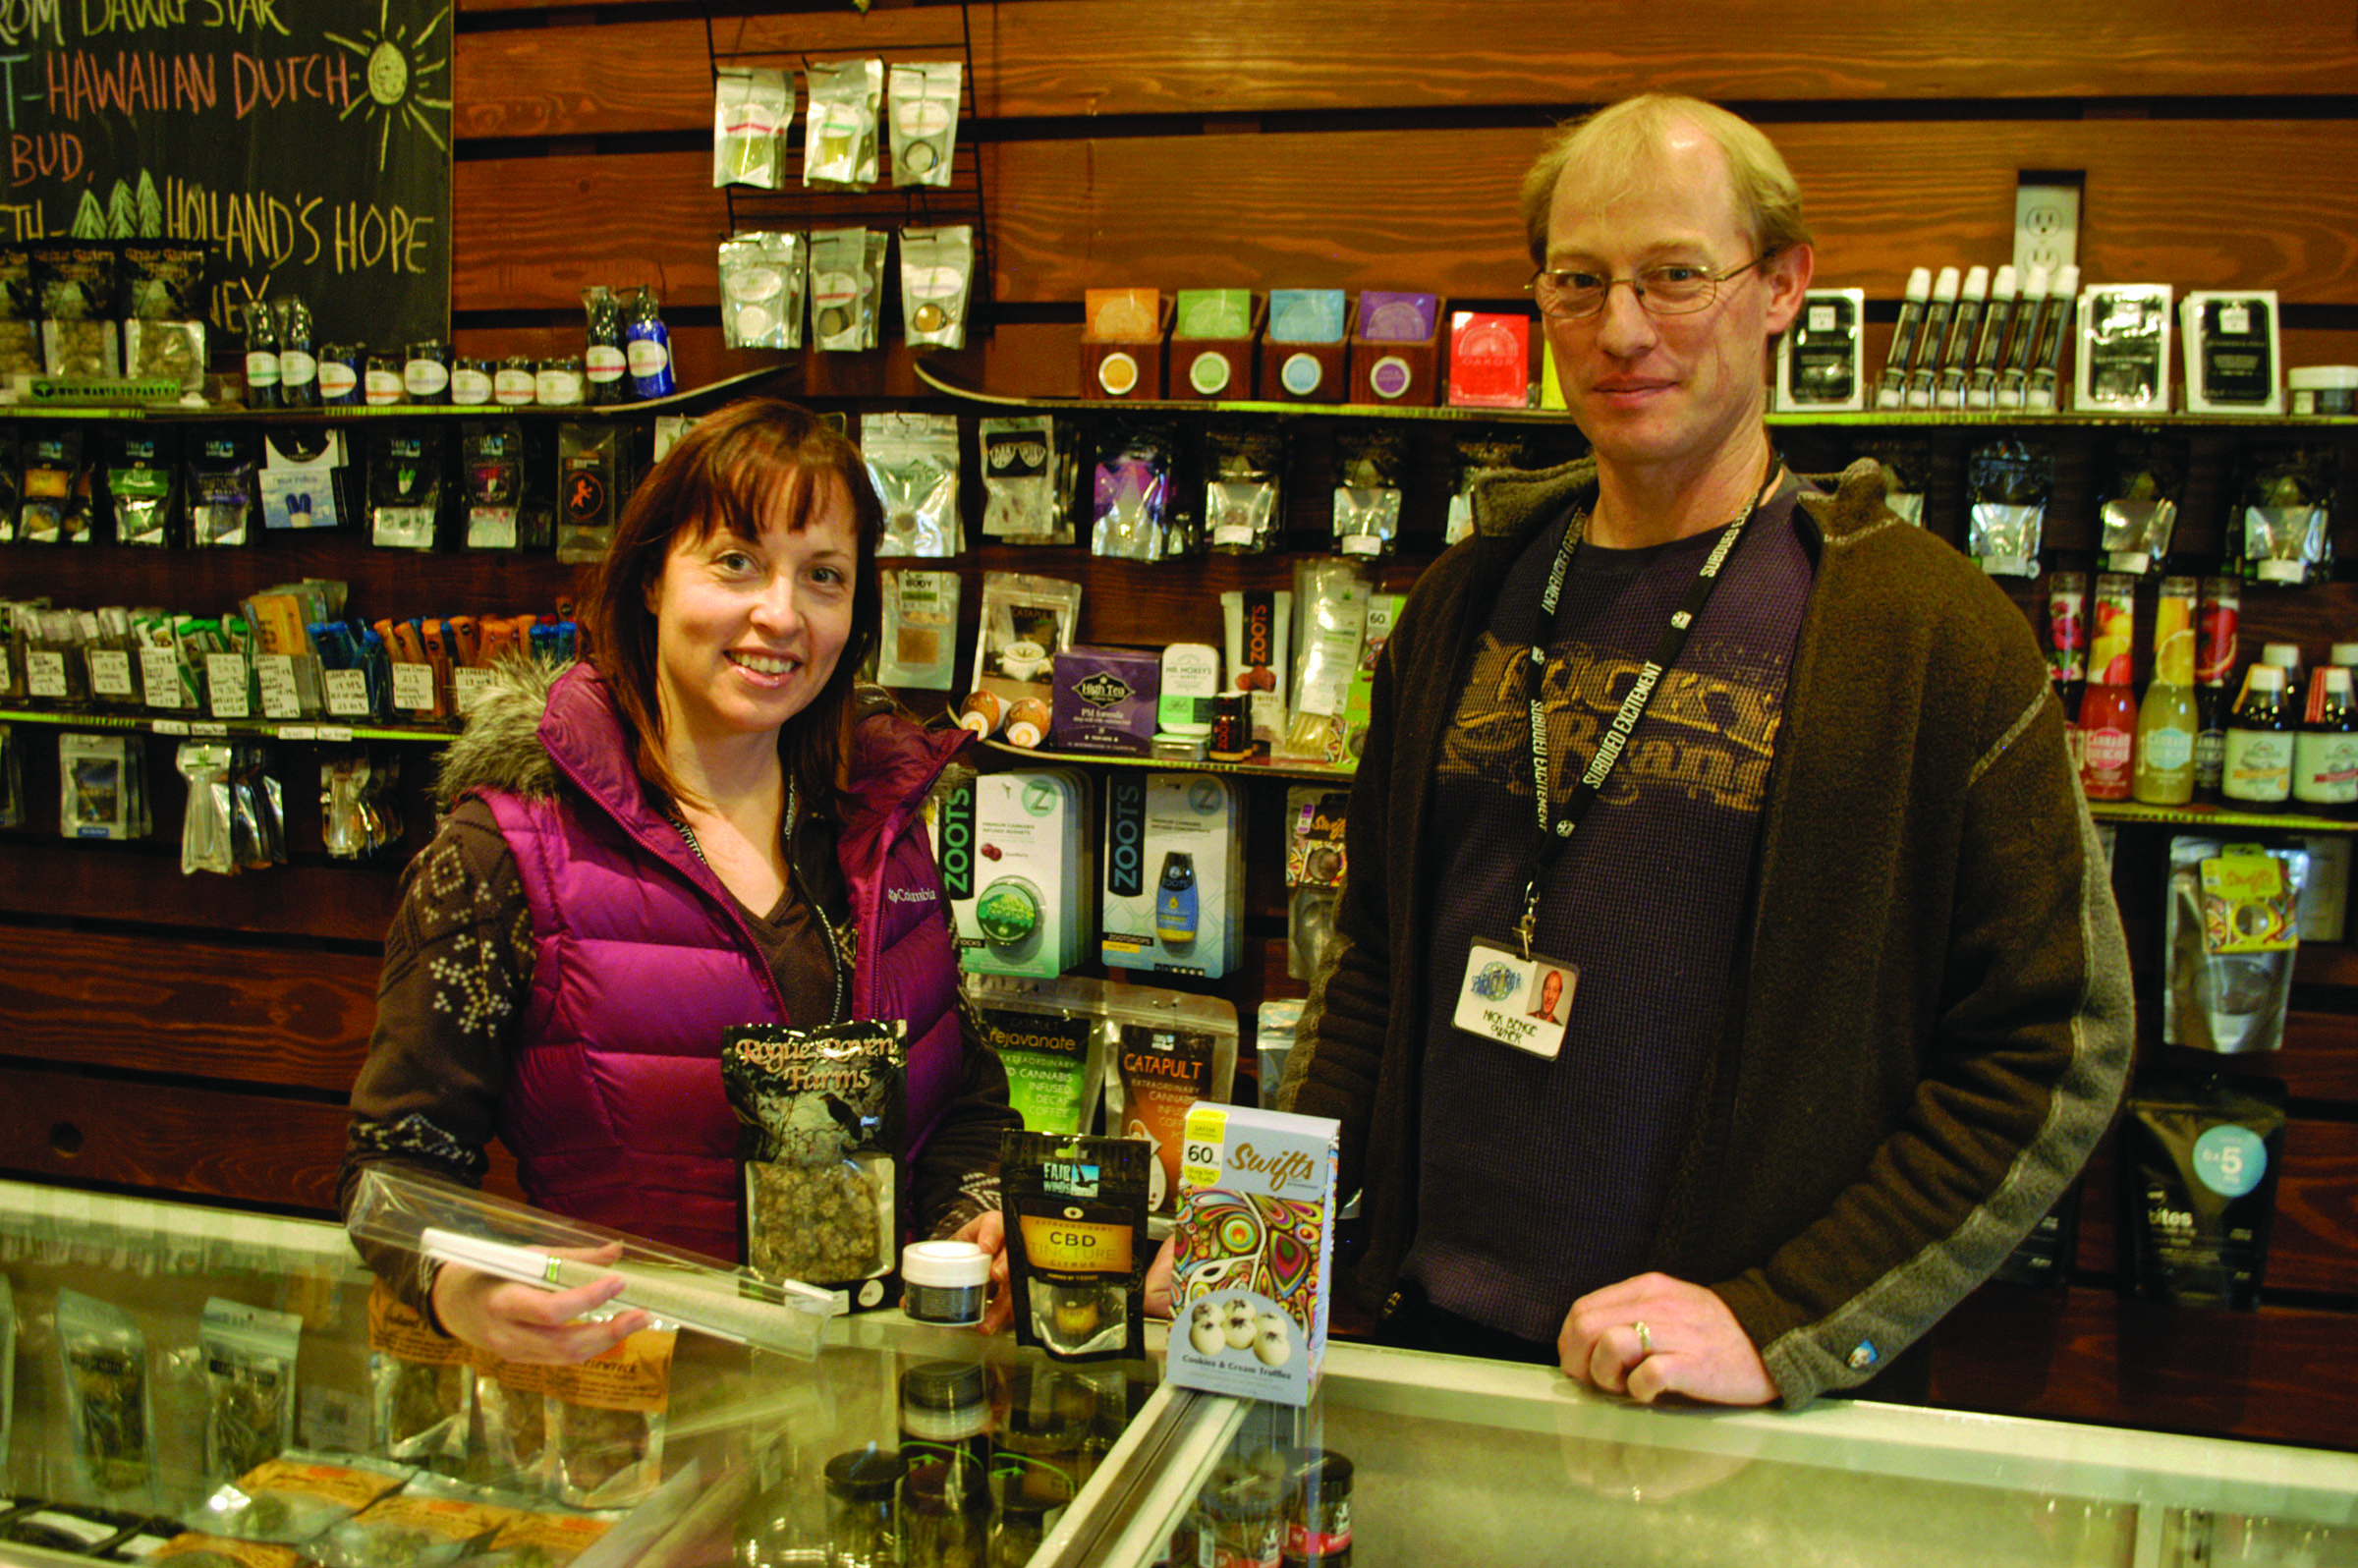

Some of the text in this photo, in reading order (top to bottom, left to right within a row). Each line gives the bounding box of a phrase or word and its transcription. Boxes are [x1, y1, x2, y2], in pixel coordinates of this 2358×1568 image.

[47, 49, 216, 120] HAWAIIAN
[233, 50, 350, 120] DUTCH
[11, 132, 94, 187] BUD,
[334, 200, 433, 274] HOPE
[1699, 528, 1740, 578] SUBDUED
[1541, 549, 1571, 616] EXCITEMENT
[1370, 612, 1386, 625] 60
[1249, 603, 1267, 664] ZOOTS
[1082, 682, 1126, 697] High Tea
[1582, 660, 1662, 790] SUBDUED EXCITEMENT
[1531, 699, 1549, 832] SUBDUED EXCITEMENT
[944, 787, 971, 893] ZOOTS
[1114, 784, 1140, 890] ZOOTS
[897, 887, 936, 902] Columbia
[960, 939, 982, 948] OCKS
[1483, 1009, 1503, 1025] NICK
[989, 1029, 1076, 1051] rejavanate
[1490, 1023, 1522, 1044] OWNER
[735, 1037, 895, 1074] Rogue Raven
[1123, 1053, 1204, 1080] CATAPULT
[782, 1065, 871, 1092] Farms
[1019, 1068, 1073, 1082] CANNABIS
[1029, 1082, 1072, 1094] INFUSED
[1037, 1093, 1070, 1105] DECAF
[1029, 1106, 1070, 1118] COFFEE
[1188, 1144, 1213, 1164] 60
[2220, 1146, 2243, 1175] 5
[1043, 1161, 1071, 1182] FAIR
[1226, 1143, 1315, 1192] Swifts
[1043, 1181, 1072, 1196] WINDS
[1029, 1242, 1117, 1260] TINCTURE
[1049, 1231, 1096, 1248] CBD
[1182, 1354, 1216, 1369] Cookies
[1218, 1360, 1226, 1369] &
[1228, 1362, 1257, 1374] Cream
[1260, 1367, 1292, 1379] Truffles
